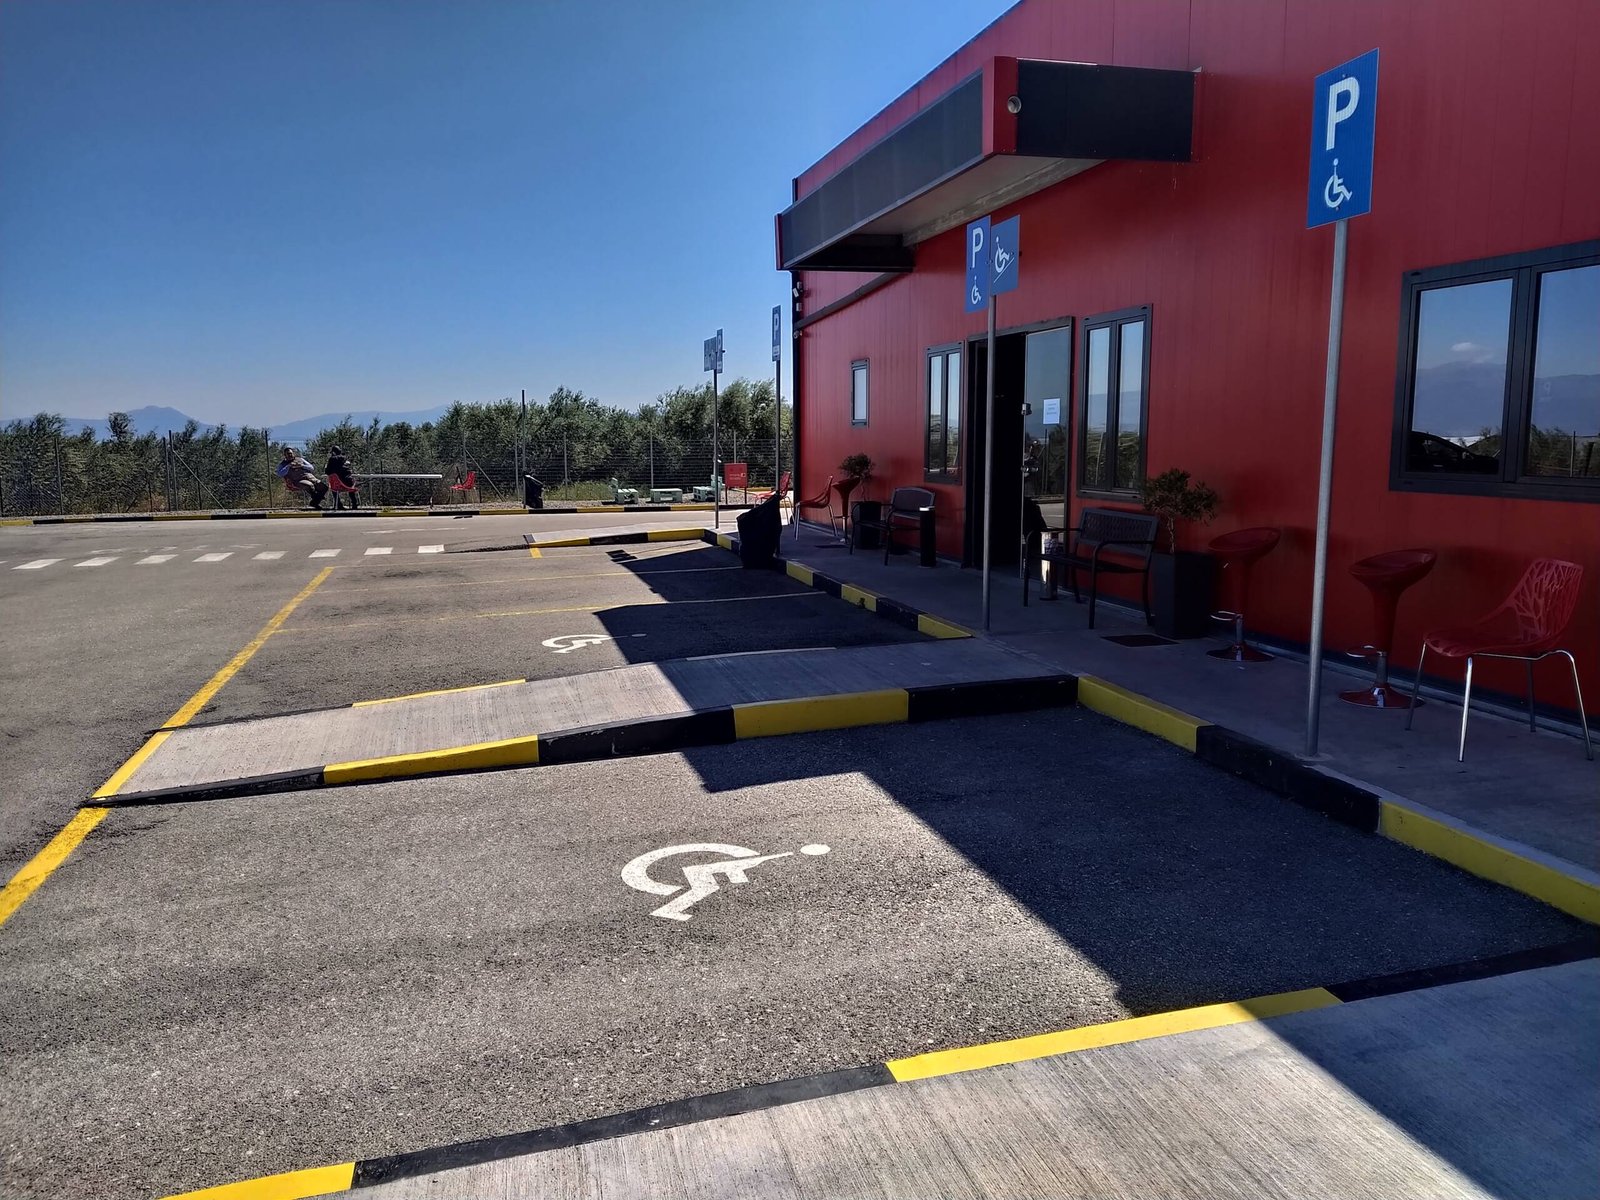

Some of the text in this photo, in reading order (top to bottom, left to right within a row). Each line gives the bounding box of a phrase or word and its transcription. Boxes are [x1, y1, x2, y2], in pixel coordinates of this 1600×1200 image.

[1326, 77, 1360, 151] P
[972, 227, 984, 269] P
[773, 313, 780, 341] P
